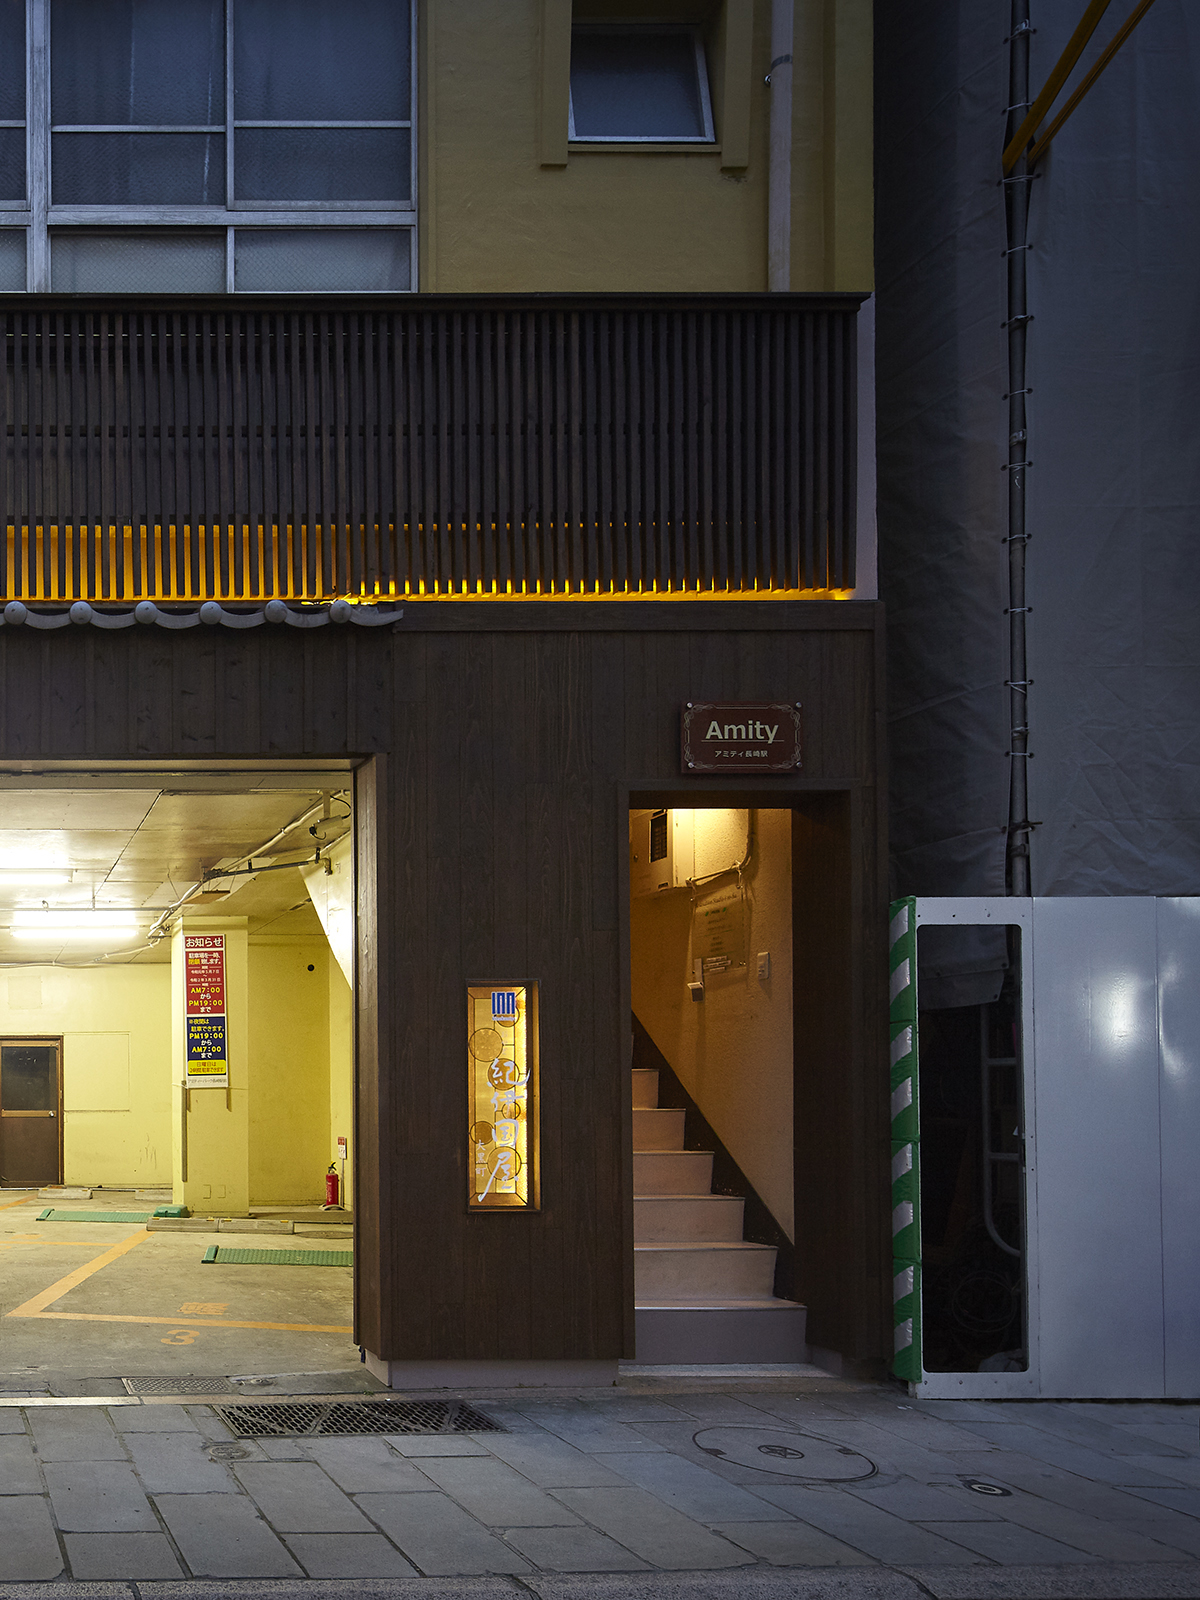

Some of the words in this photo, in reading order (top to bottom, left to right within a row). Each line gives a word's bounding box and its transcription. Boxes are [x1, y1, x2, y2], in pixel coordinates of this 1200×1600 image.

[705, 720, 779, 744] Amity
[715, 750, 768, 758] アミティ長崎駅
[186, 937, 222, 947] お知らせ
[160, 1329, 200, 1345] 3
